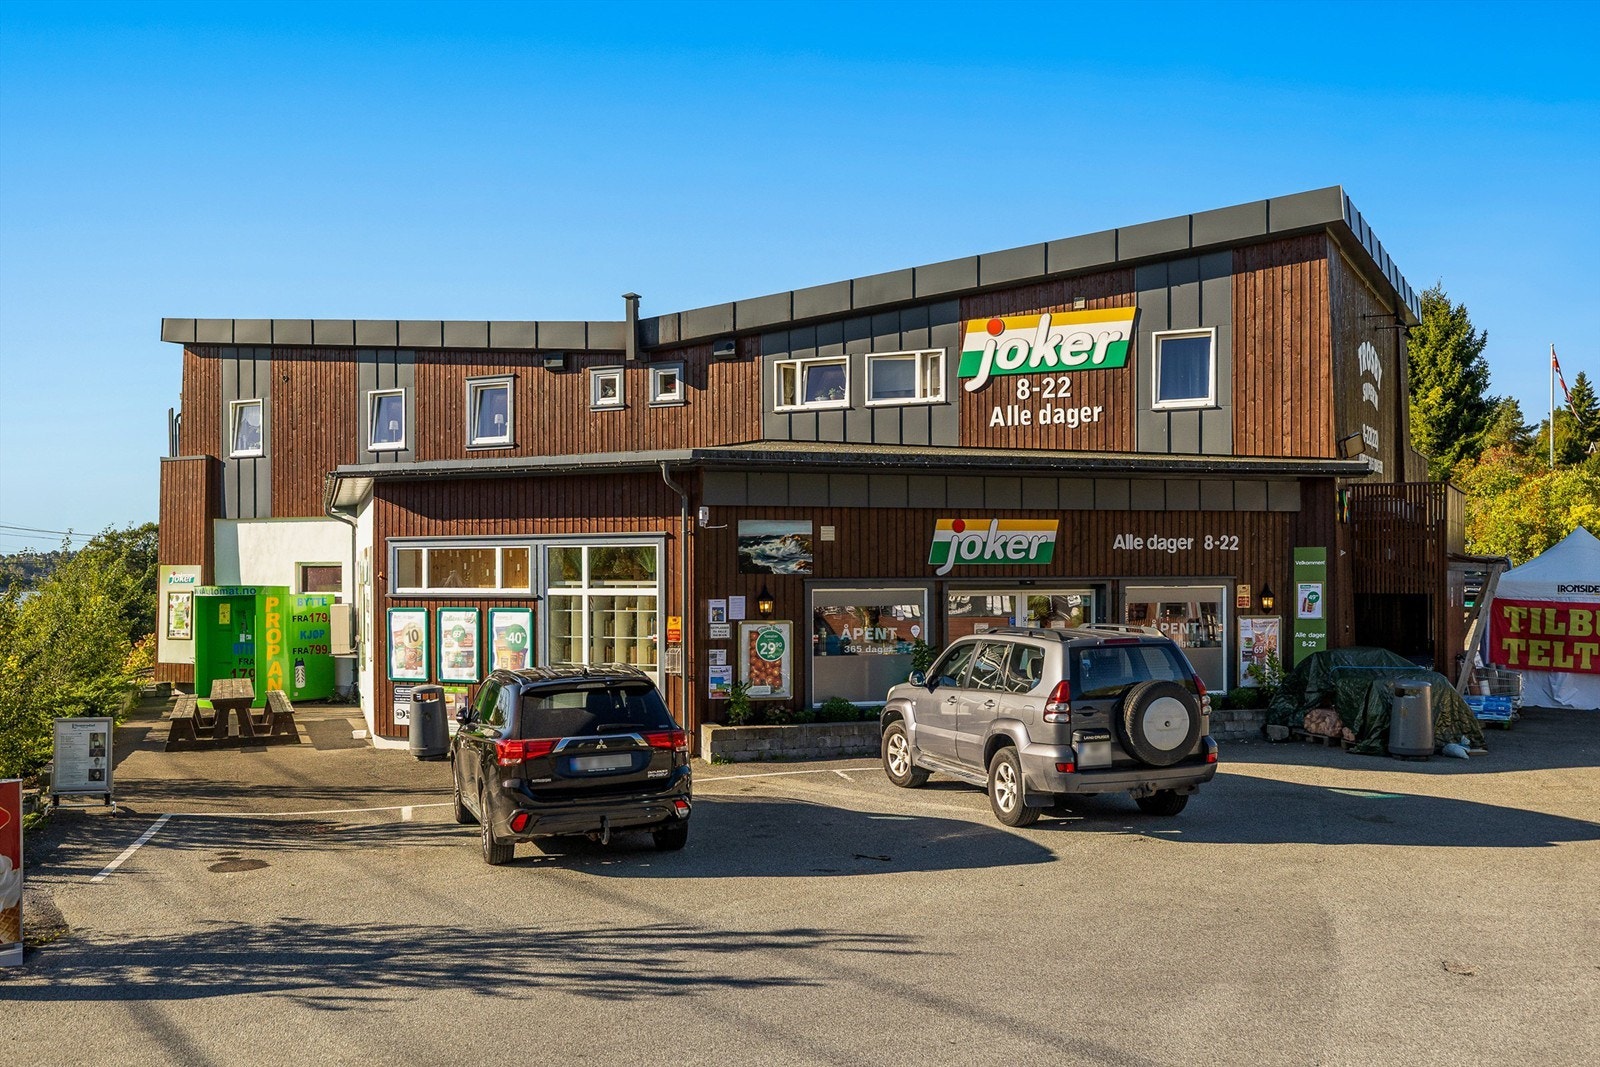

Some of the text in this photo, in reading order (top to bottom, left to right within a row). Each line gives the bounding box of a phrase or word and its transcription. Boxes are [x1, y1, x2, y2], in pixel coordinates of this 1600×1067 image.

[965, 313, 1123, 392] joker
[1016, 377, 1072, 400] 8-22
[989, 403, 1103, 429] Alle dager
[936, 518, 1048, 576] joker
[1113, 533, 1239, 553] Alle dager 8-22
[169, 571, 195, 585] joker
[297, 598, 327, 606] BYTTE
[840, 624, 898, 640] ÅPENT
[1503, 606, 1600, 637] TILB
[265, 597, 283, 691] PROPAN
[300, 630, 325, 639] KJØP
[292, 647, 309, 655] FRA
[844, 645, 862, 653] 365
[1502, 638, 1599, 669] TELT
